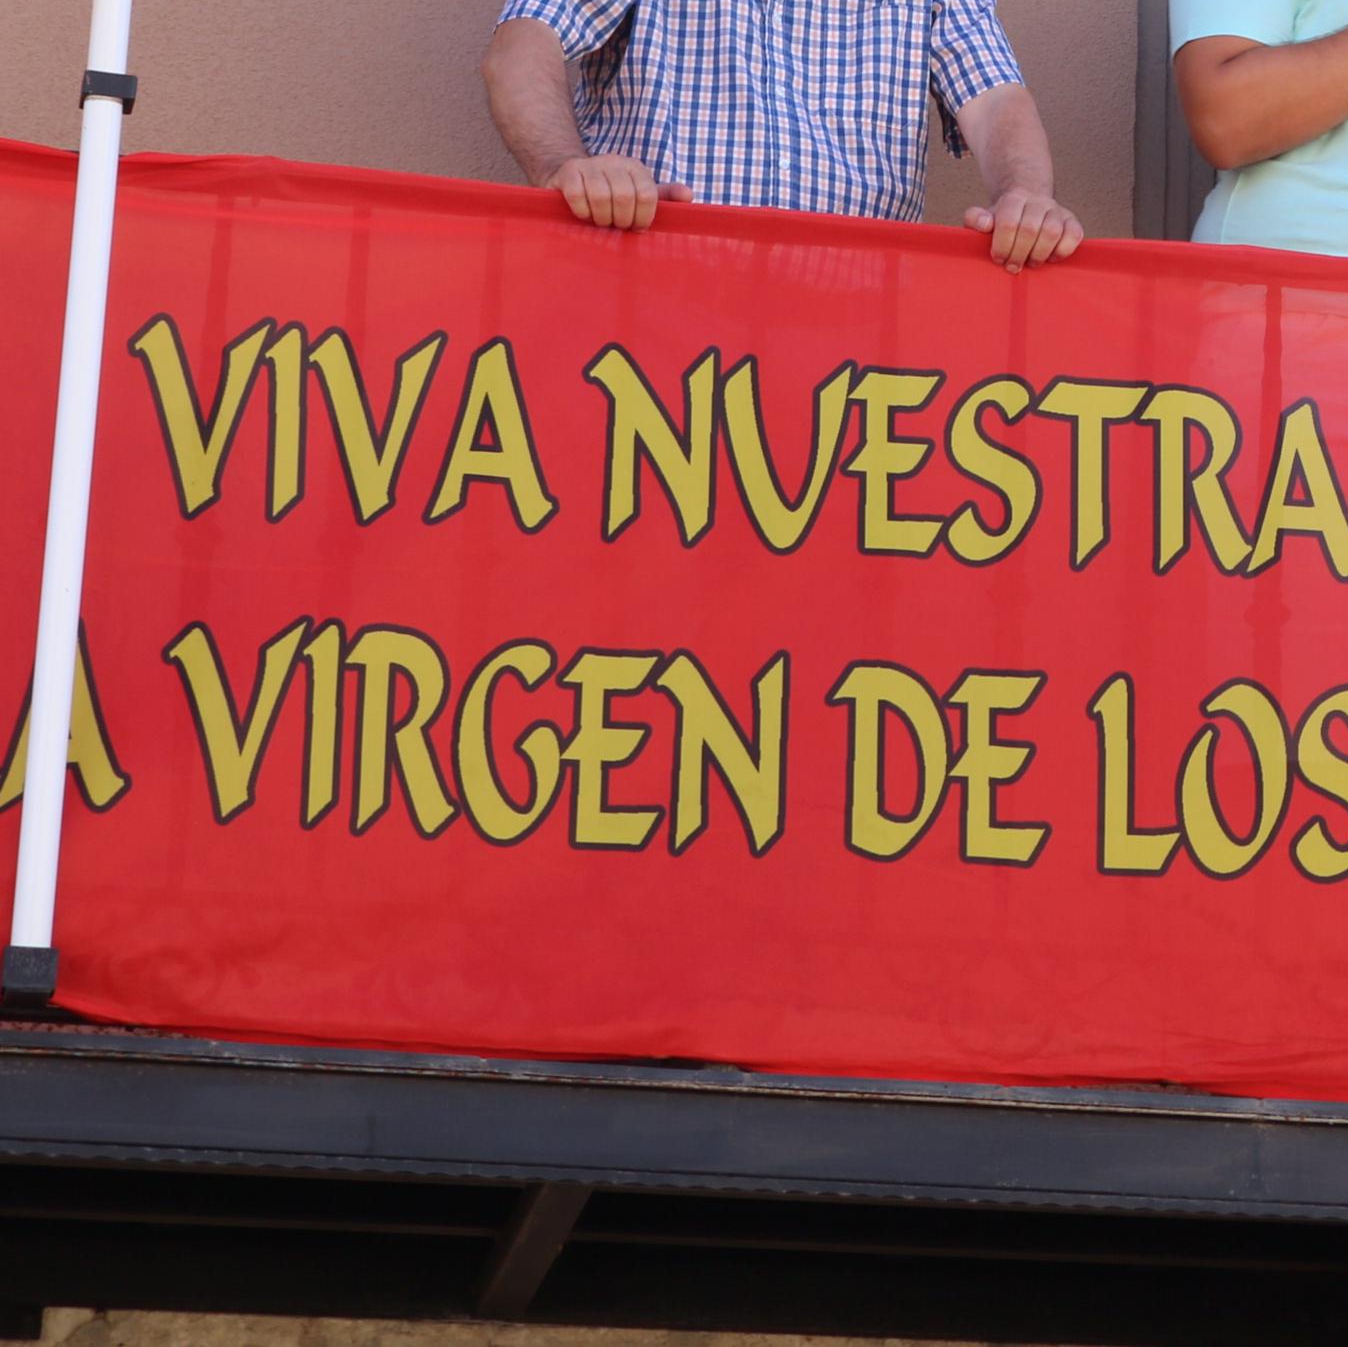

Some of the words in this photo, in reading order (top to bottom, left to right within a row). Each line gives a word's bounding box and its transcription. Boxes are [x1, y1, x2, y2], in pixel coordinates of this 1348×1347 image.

[128, 313, 558, 533] VIVA
[162, 614, 790, 858] VIRGEN
[825, 660, 1053, 870] DE
